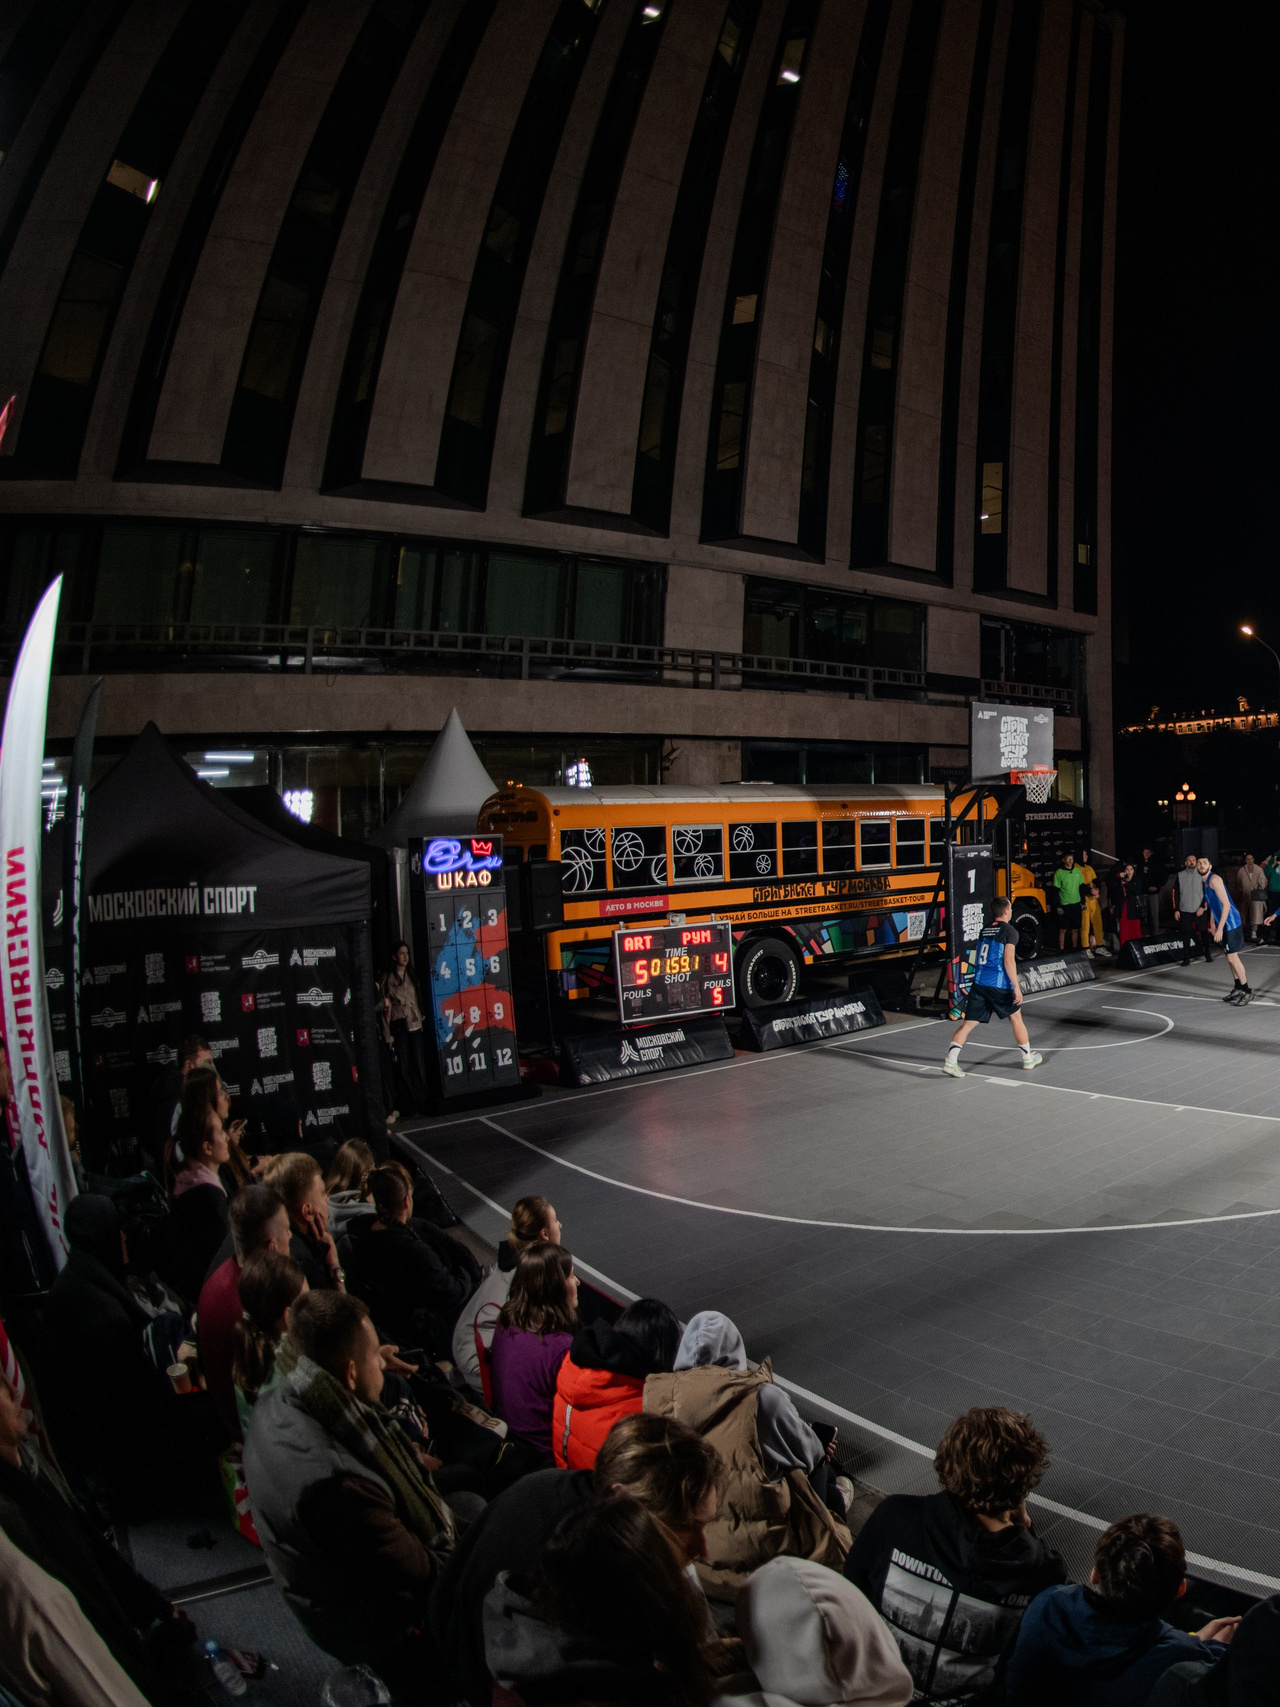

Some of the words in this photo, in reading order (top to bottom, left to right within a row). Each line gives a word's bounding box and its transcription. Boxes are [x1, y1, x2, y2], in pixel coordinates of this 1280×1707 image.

[1025, 812, 1073, 820] STREETBASKET
[437, 869, 492, 890] ШКАФ
[968, 868, 977, 893] 1
[88, 881, 200, 923] МОСКОВСКИЙ
[203, 886, 257, 915] СПОРТ
[606, 903, 625, 911] ЛЕТО
[633, 900, 664, 909] МОСКВЕ
[439, 913, 447, 931] 1
[462, 910, 473, 929] 2
[488, 909, 498, 926] 3
[747, 909, 779, 920] БОЛЬШЕ
[781, 907, 792, 917] НА
[624, 935, 653, 952] ART
[664, 947, 688, 959] TIME
[714, 952, 728, 973] 4
[979, 943, 990, 966] 9
[440, 961, 451, 979] 4
[465, 958, 476, 976] 5
[489, 956, 500, 973] 6
[634, 960, 649, 984] 5
[664, 971, 691, 984] SHOT
[623, 988, 652, 1000] FOULS
[703, 978, 732, 990] FOULS
[713, 987, 723, 1005] 5
[445, 1009, 454, 1027] 7
[469, 1006, 480, 1024] 8
[494, 1003, 504, 1020] 9
[636, 1028, 686, 1049] МОСКОВСКИЙ
[446, 1055, 463, 1075] 10
[471, 1053, 487, 1070] 11
[496, 1048, 513, 1066] 12
[640, 1046, 664, 1061] СПОРТ
